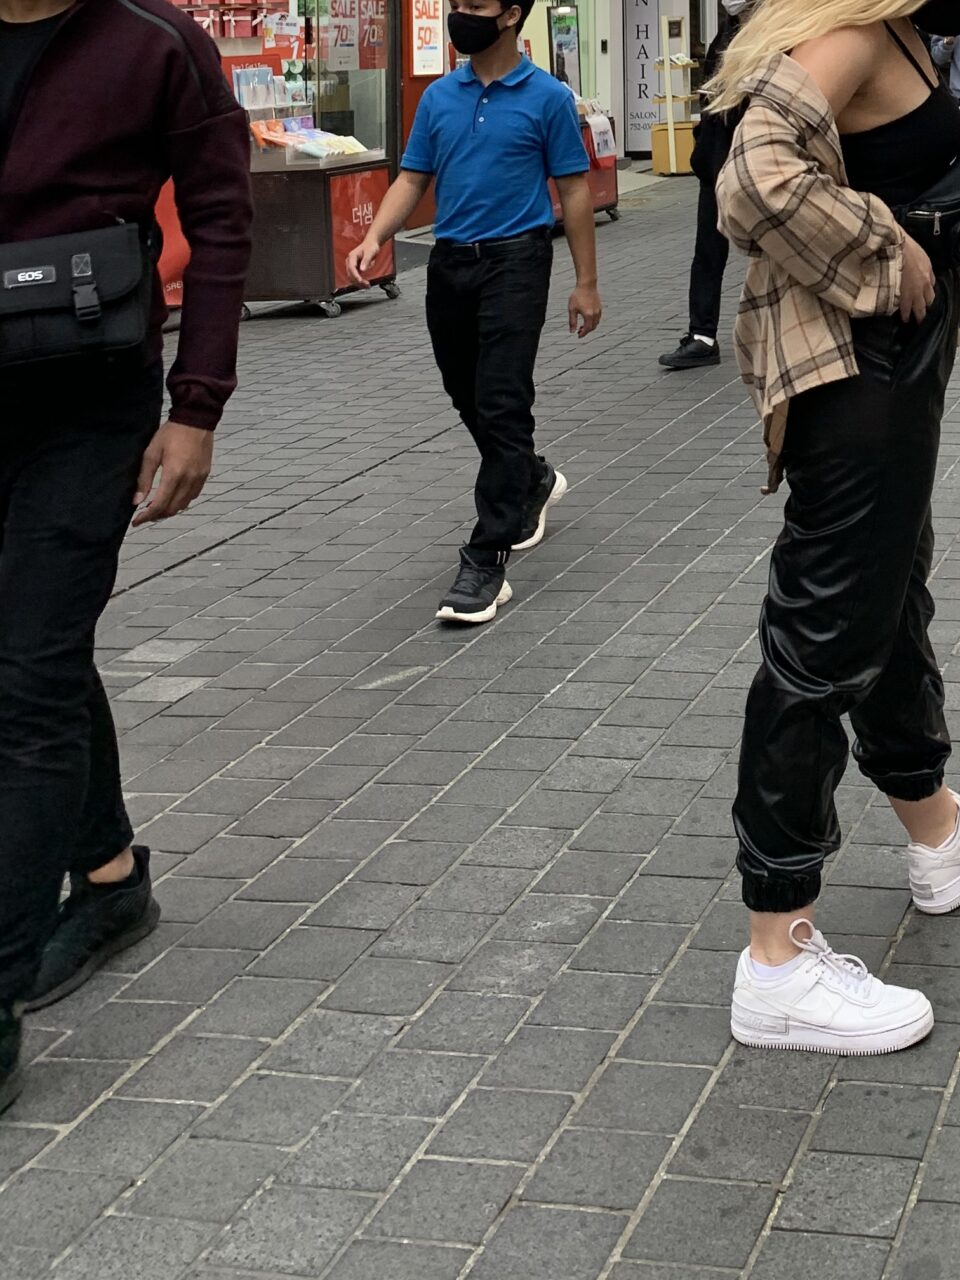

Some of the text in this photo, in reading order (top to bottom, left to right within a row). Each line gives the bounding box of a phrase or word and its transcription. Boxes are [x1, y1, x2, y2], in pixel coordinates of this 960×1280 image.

[330, 0, 356, 19] SALE
[360, 0, 385, 20] SALE
[414, 0, 440, 20] SALE
[635, 24, 650, 100] HAIR
[629, 111, 657, 121] SALON
[629, 122, 654, 132] 752-03
[352, 201, 374, 227] 더샘
[17, 270, 44, 282] EOS
[165, 280, 184, 292] SAE
